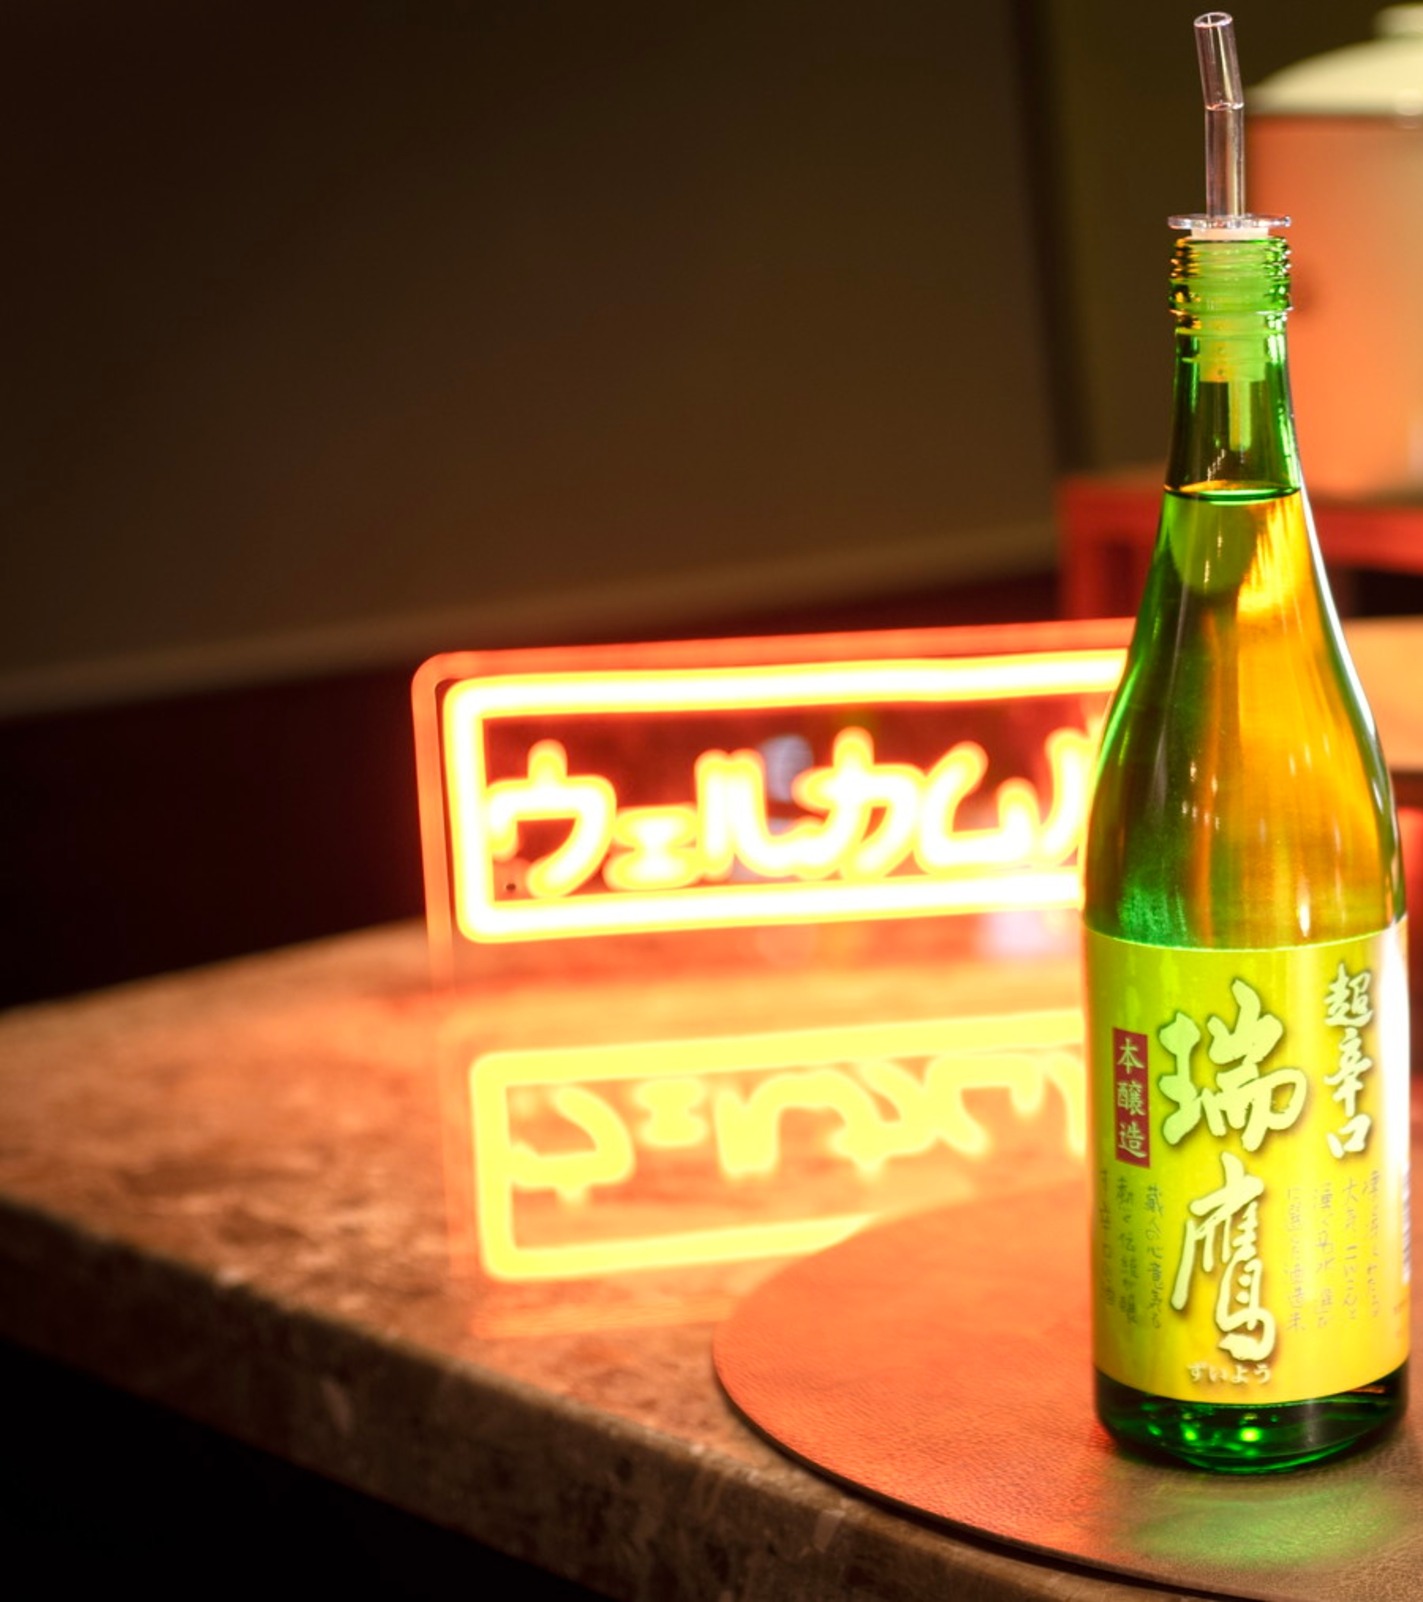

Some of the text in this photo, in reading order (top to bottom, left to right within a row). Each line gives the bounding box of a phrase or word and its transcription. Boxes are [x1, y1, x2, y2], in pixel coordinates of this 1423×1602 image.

[1116, 1037, 1148, 1159] 本醸造
[1323, 960, 1373, 1159] 超辛口
[1157, 978, 1307, 1362] 瑞鷹
[1187, 1361, 1272, 1385] ずいよう
